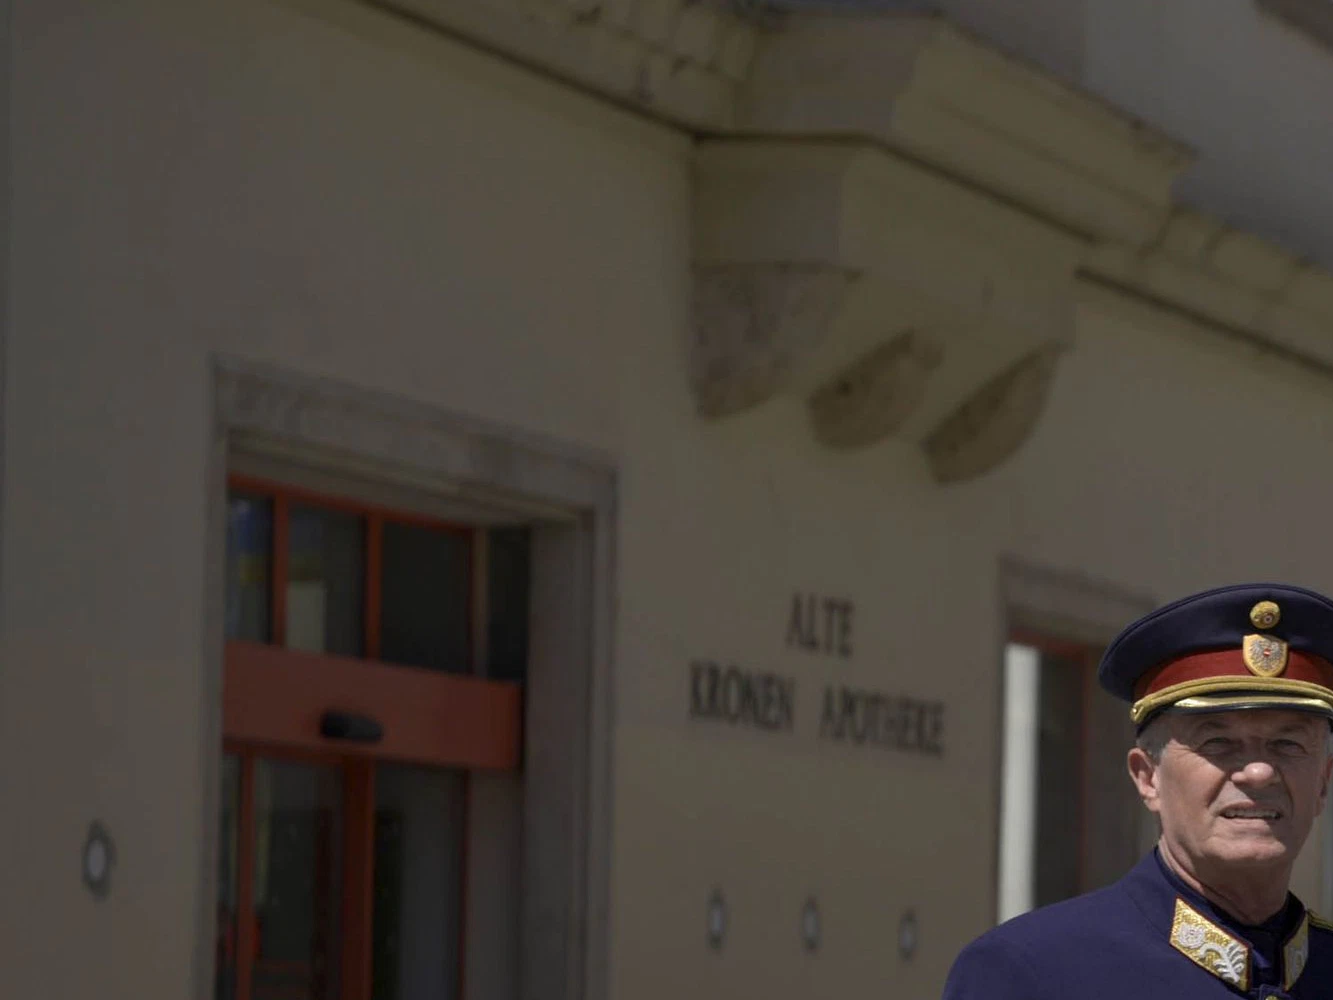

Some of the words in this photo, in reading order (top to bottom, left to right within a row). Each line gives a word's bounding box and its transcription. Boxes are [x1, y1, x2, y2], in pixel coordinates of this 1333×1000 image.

[784, 591, 855, 659] ALTE
[688, 658, 796, 734] KRONEN
[819, 683, 945, 760] APOTHEKE
